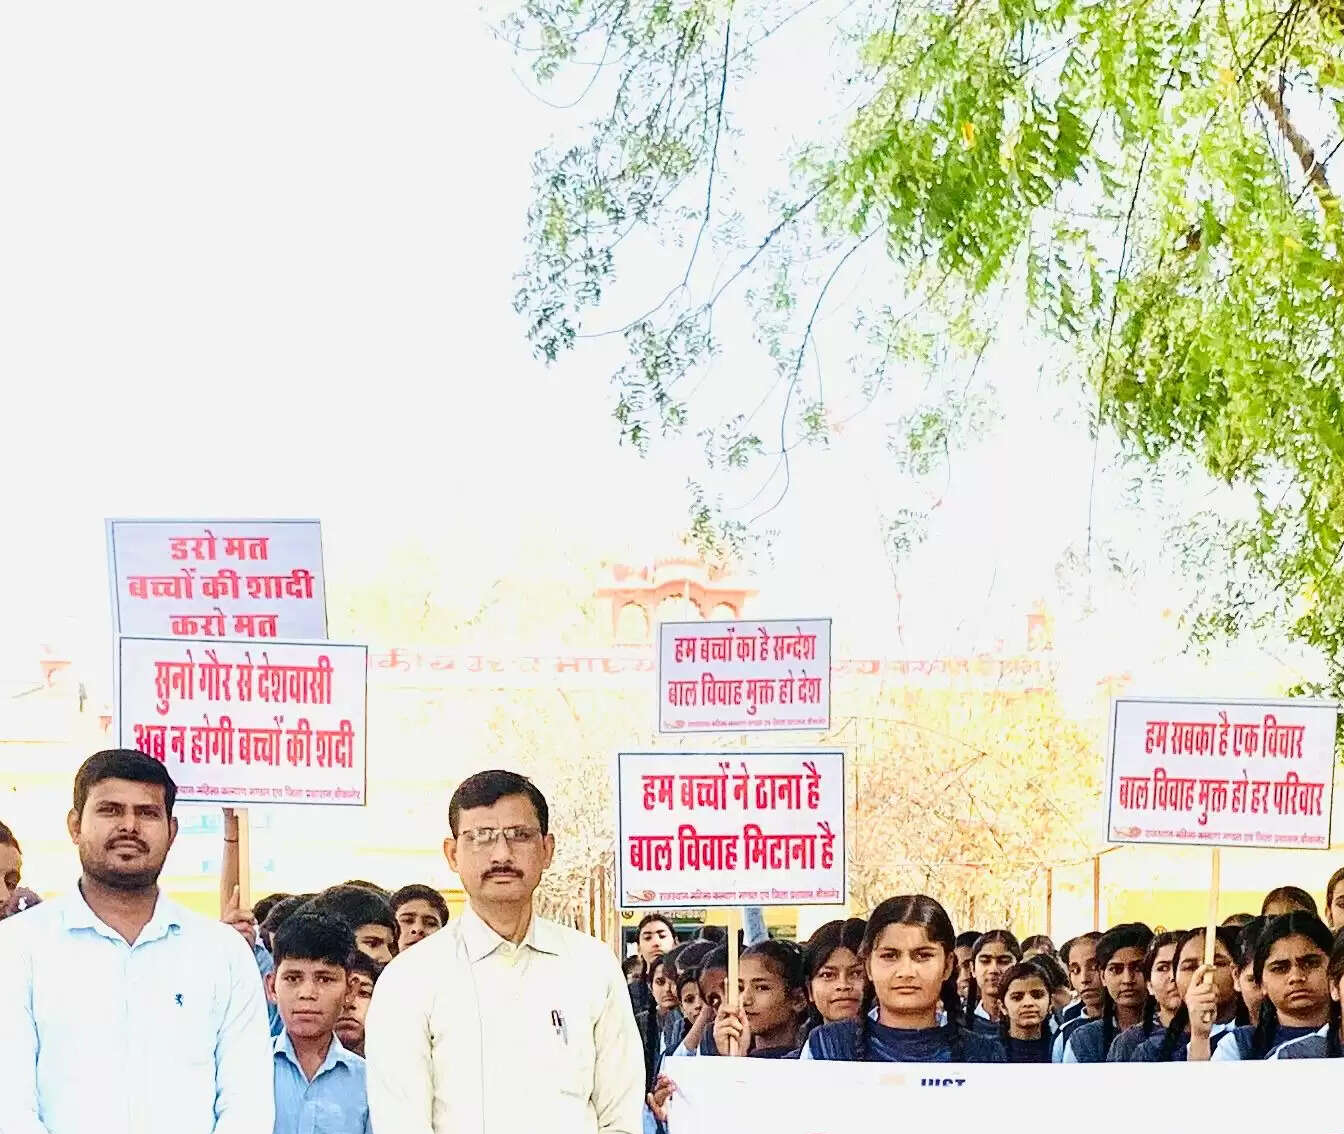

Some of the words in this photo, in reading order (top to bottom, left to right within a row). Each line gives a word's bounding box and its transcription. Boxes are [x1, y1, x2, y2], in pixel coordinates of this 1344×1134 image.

[168, 529, 217, 561] डरो
[222, 537, 269, 561] मत
[127, 567, 196, 600] बच्चों
[200, 568, 241, 600] की
[246, 567, 315, 600] शादी
[169, 606, 227, 637] करो
[232, 614, 279, 638] मत
[674, 636, 697, 663] हम
[699, 627, 735, 663] बच्चों
[736, 636, 756, 663] का
[758, 627, 770, 662] है
[773, 626, 816, 661] सन्देश
[154, 649, 194, 715] सुनो
[199, 649, 233, 701] गौर
[236, 650, 254, 702] से
[257, 650, 334, 704] देशवासी
[668, 680, 698, 706] बाल
[701, 672, 743, 706] विवाह
[746, 678, 776, 715] मुक्त
[779, 669, 795, 704] हो
[798, 669, 822, 704] देश
[134, 724, 167, 762] अब
[171, 726, 186, 763] न
[190, 713, 235, 765] होगी
[238, 715, 282, 766] बच्चों
[286, 718, 313, 767] की
[1145, 720, 1169, 754] हम
[1218, 710, 1231, 757] है
[1233, 723, 1261, 758] एक
[1262, 714, 1306, 759] विचार
[641, 774, 675, 810] हम
[679, 762, 730, 810] बच्चों
[732, 762, 748, 810] ने
[755, 774, 803, 810] ठाना
[802, 761, 821, 809] है
[1119, 776, 1151, 811] बाल
[1152, 767, 1196, 812] विवाह
[1197, 779, 1230, 825] मुक्त
[1231, 769, 1250, 814] हो
[1251, 781, 1271, 814] हर
[1274, 771, 1325, 816] परिवार
[629, 835, 674, 871] बाल
[678, 824, 739, 871] विवाह
[743, 824, 818, 871] मिटाना
[817, 820, 836, 870] है
